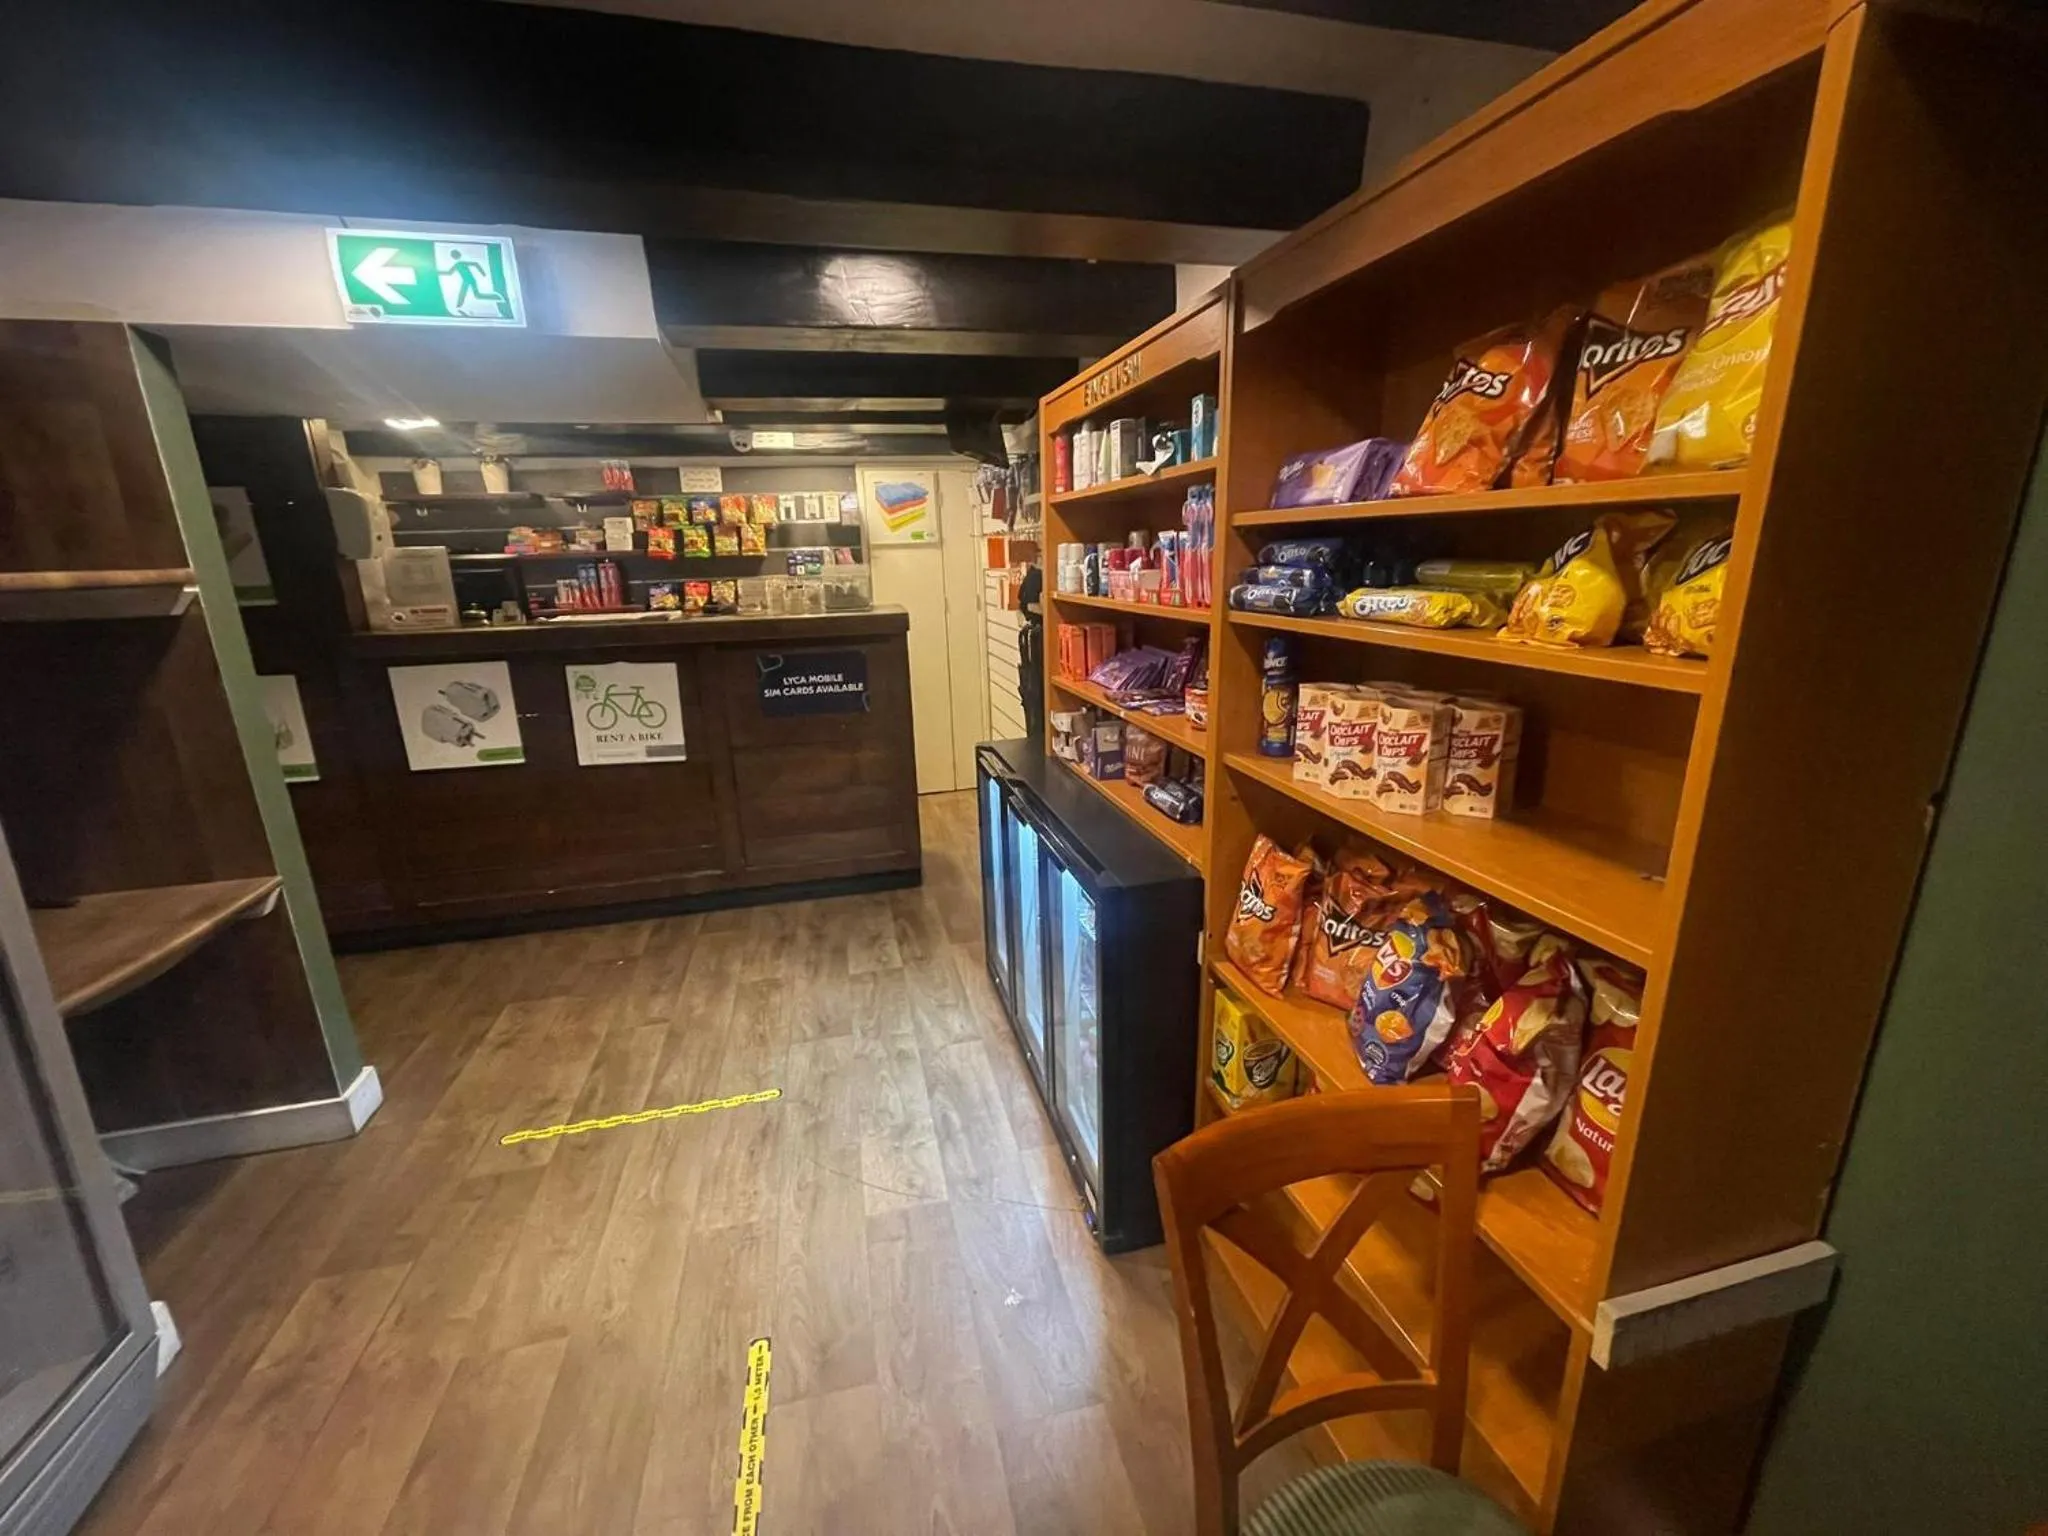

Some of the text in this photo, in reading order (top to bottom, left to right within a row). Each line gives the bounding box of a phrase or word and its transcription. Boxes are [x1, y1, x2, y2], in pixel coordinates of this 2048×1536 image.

[1582, 328, 1686, 368] oritos
[1083, 352, 1142, 408] ENGLISH
[764, 682, 864, 698] SIM CARDS AVAILABLE
[783, 673, 844, 685] LYCA MOBILE
[596, 731, 663, 744] RENT A BIKE
[1322, 917, 1385, 947] oritos
[1575, 1116, 1614, 1152] Natur
[755, 1355, 764, 1386] METER
[749, 1417, 759, 1452] OTHER
[746, 1453, 755, 1485] EACH
[743, 1485, 754, 1518] FROM
